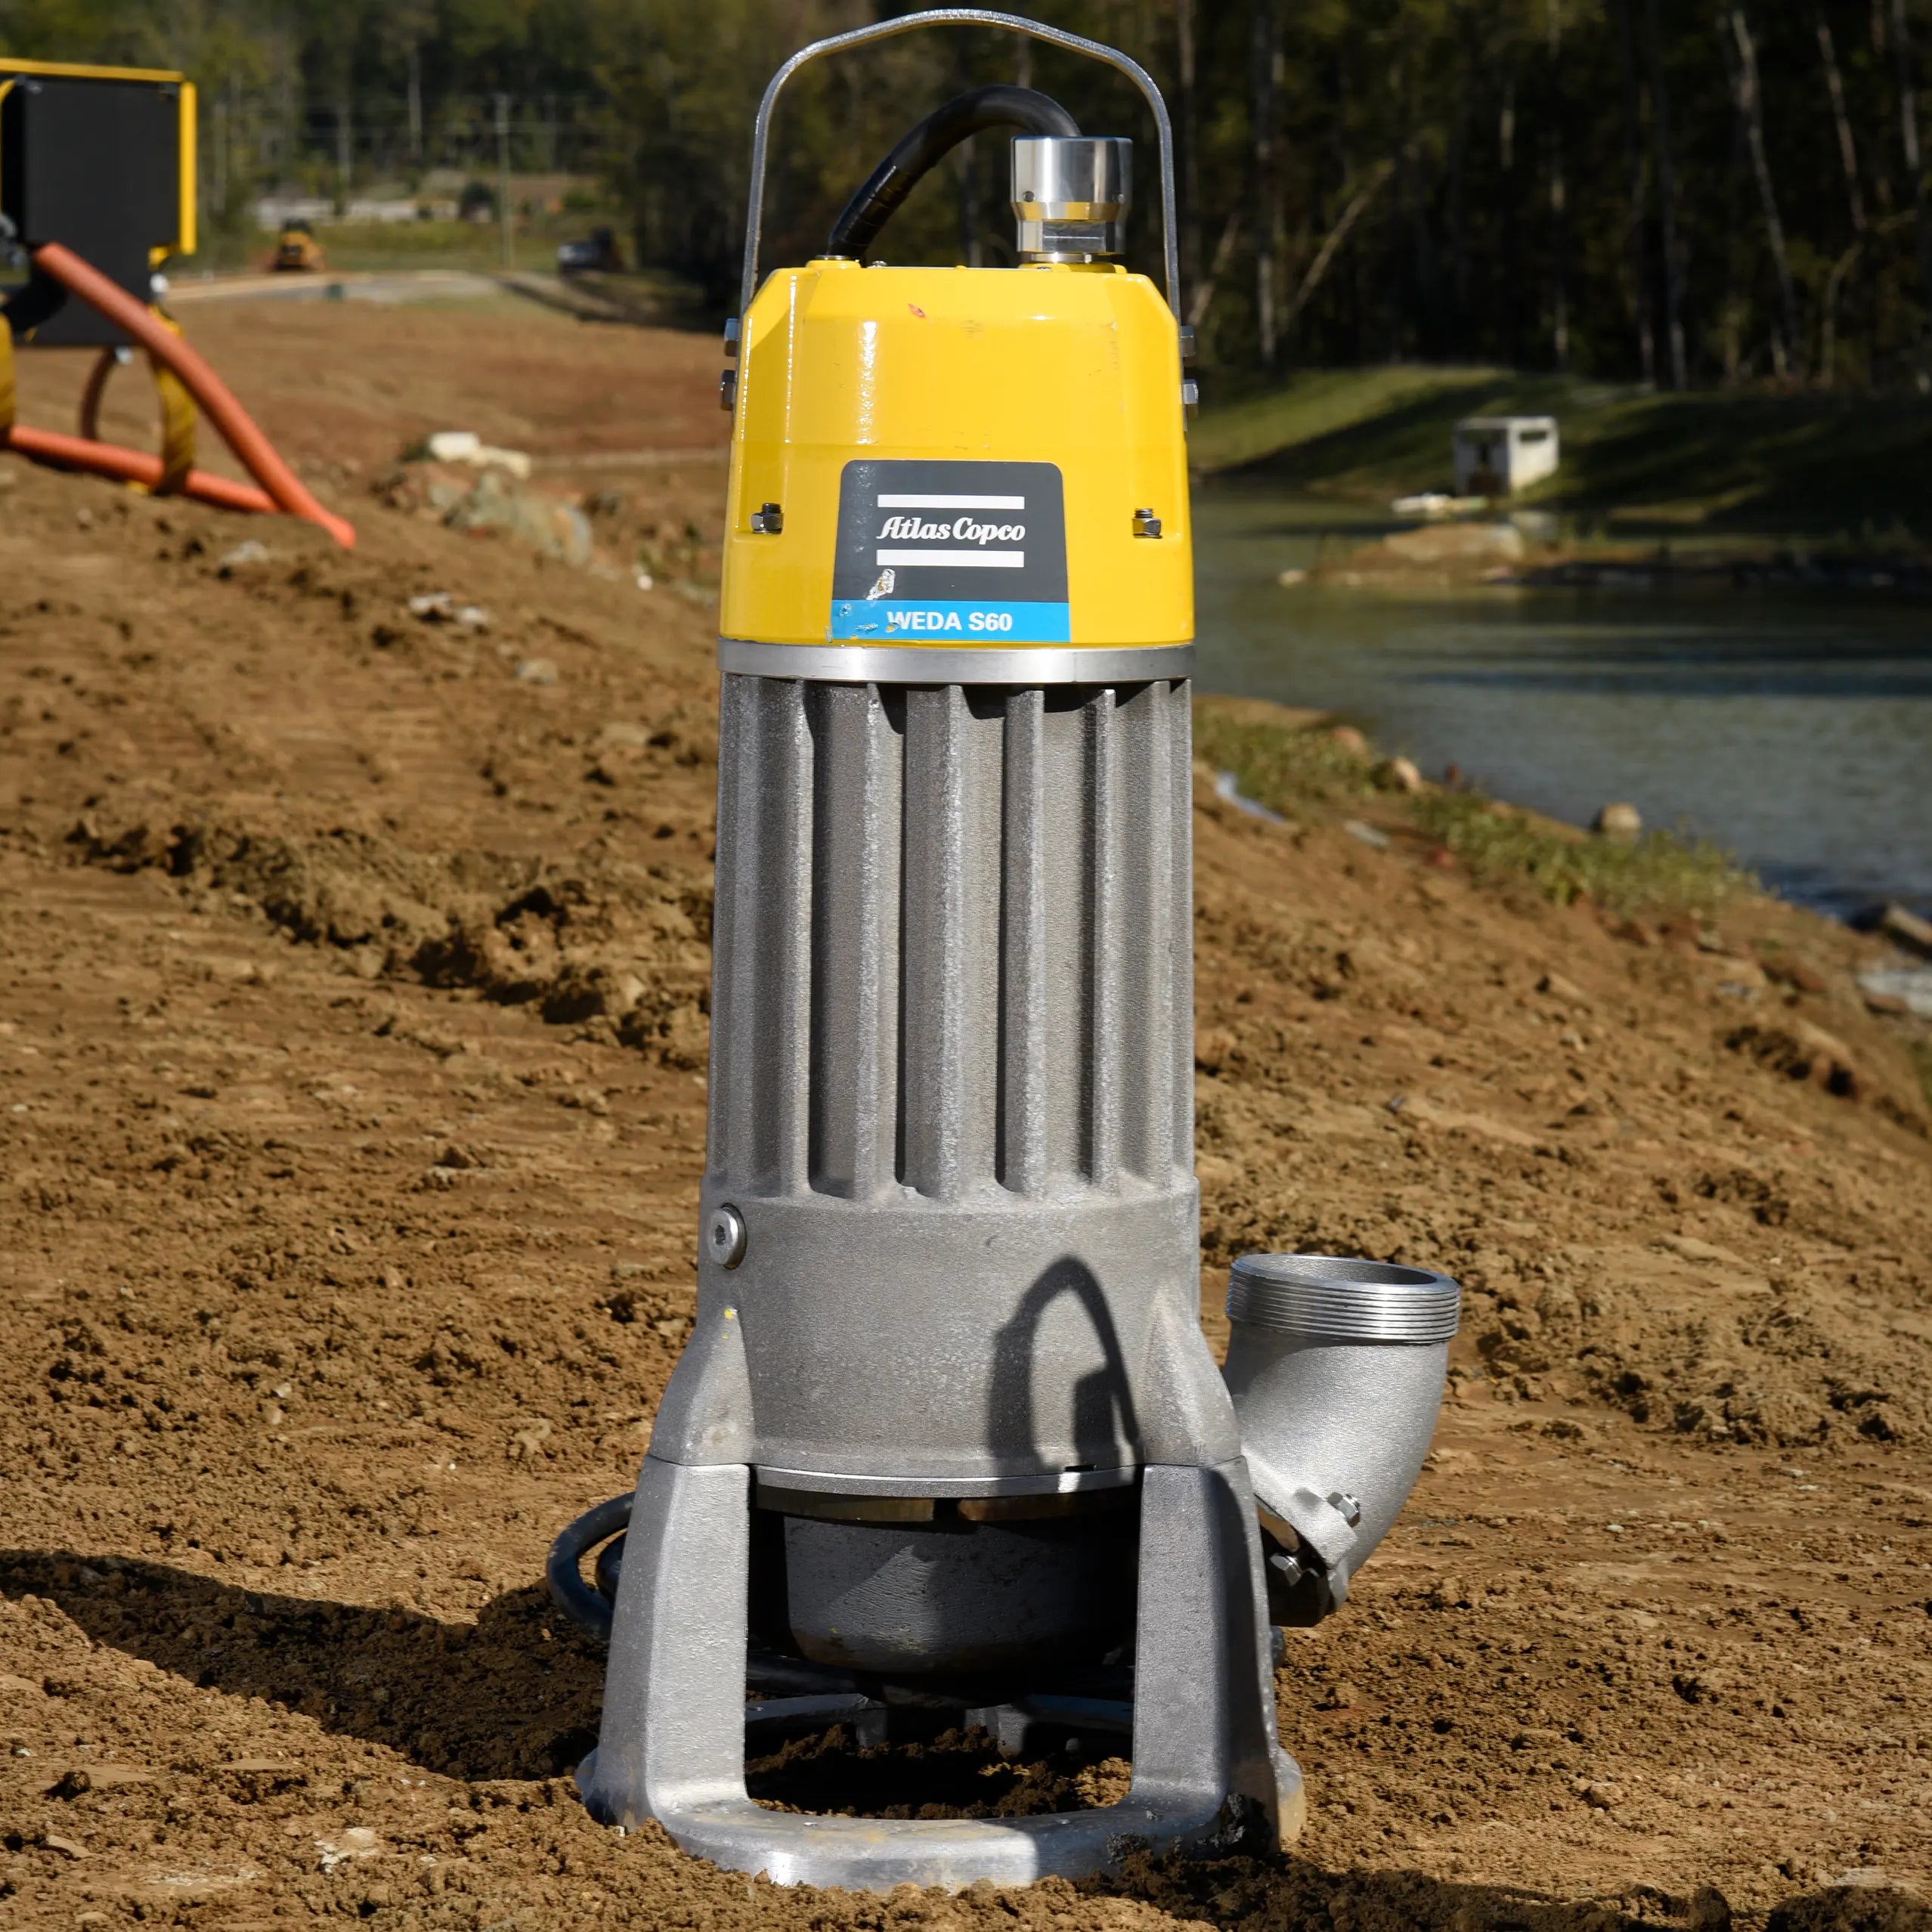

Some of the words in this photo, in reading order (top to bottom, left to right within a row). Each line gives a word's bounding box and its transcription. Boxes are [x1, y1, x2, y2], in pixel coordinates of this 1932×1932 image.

[876, 516, 951, 540] Atlas
[952, 516, 1026, 545] Copco
[887, 611, 962, 630] WEDA
[968, 611, 1013, 631] S60
